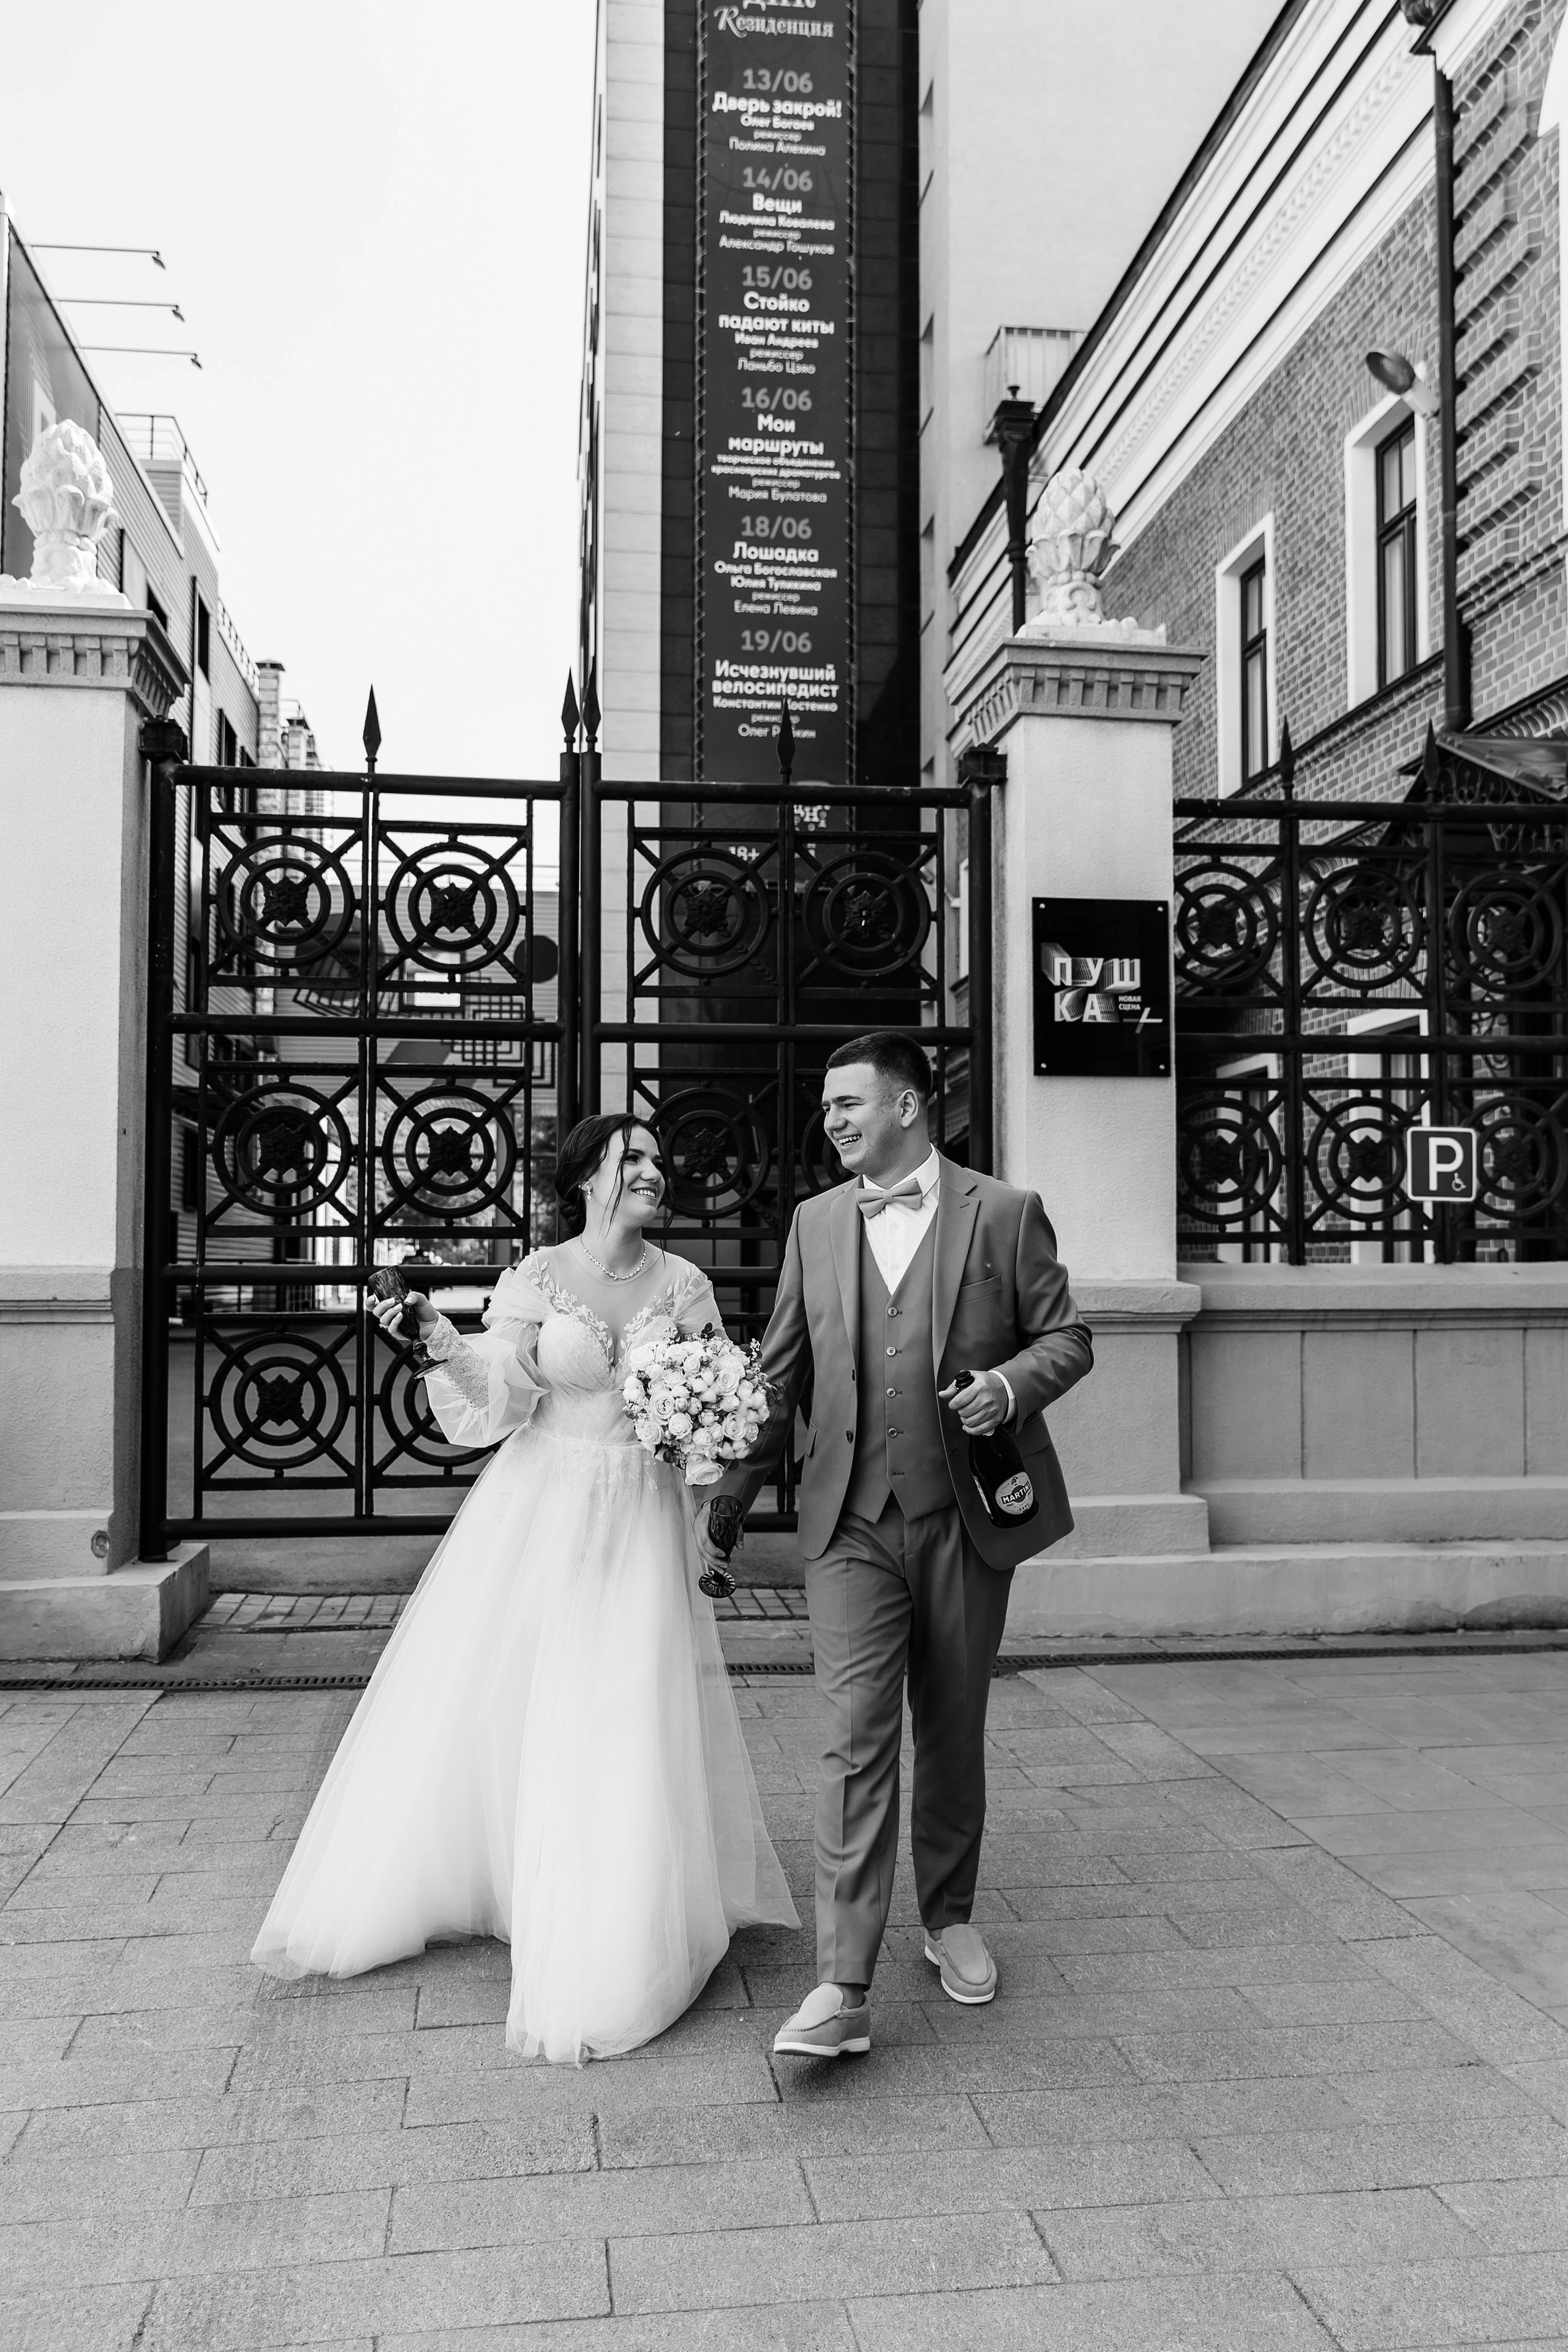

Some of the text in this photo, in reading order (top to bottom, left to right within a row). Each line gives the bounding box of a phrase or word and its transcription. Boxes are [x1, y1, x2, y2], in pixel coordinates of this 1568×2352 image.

[743, 69, 813, 92] 13/06
[712, 91, 842, 119] Дверь закрой!
[741, 113, 815, 131] Олег Богаев
[729, 136, 774, 153] Полина
[743, 167, 813, 191] 14/06
[753, 192, 802, 215] Вещи
[719, 210, 777, 227] Людмила
[719, 235, 785, 253] Александр
[742, 265, 812, 290] 15/06
[743, 291, 810, 312] Стойко
[718, 314, 835, 334] падают киты
[735, 331, 819, 349] Иван Андреев
[750, 348, 804, 361] режиссер
[742, 387, 812, 411] 16/06
[757, 413, 796, 432] Мои
[728, 437, 824, 457] маршруты
[728, 486, 827, 503] Мария Булатова
[741, 516, 812, 539] 18/06
[733, 541, 819, 564] Лошадка
[714, 560, 837, 578] Ольга Богославская
[731, 575, 766, 589] Юлия
[752, 592, 801, 603] режиссер
[734, 600, 818, 616] Елена Левина
[741, 630, 812, 653] 19/06
[715, 660, 835, 683] Исчезнувший
[712, 680, 840, 699] велосипедист
[713, 695, 782, 709] Константин
[751, 714, 800, 725] режиср
[738, 723, 816, 739] Олег Ркин
[1428, 1137, 1464, 1191] P
[1002, 1482, 1030, 1503] MARTINI
